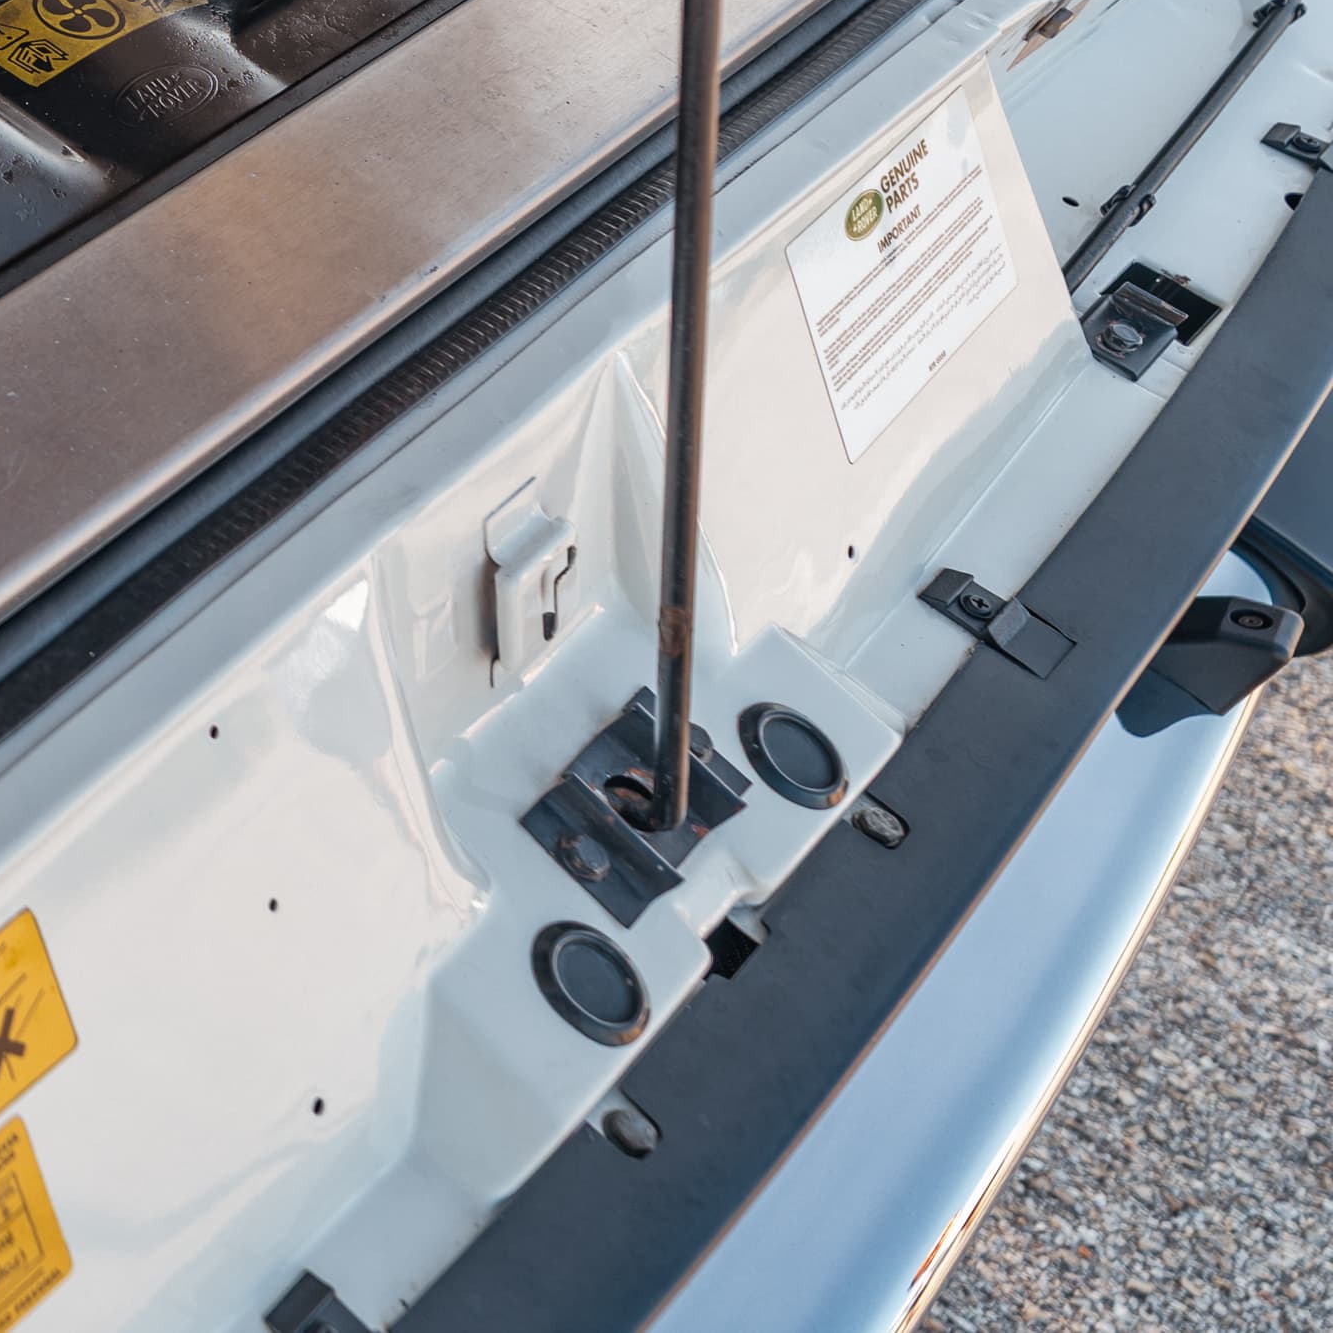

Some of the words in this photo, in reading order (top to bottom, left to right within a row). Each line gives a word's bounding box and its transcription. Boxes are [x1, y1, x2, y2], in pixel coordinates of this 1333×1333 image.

[880, 139, 929, 193] GENUINE
[852, 197, 873, 222] LAND
[885, 172, 919, 214] PARTS
[856, 206, 878, 234] ROVER
[877, 204, 921, 253] IMPORTANT
